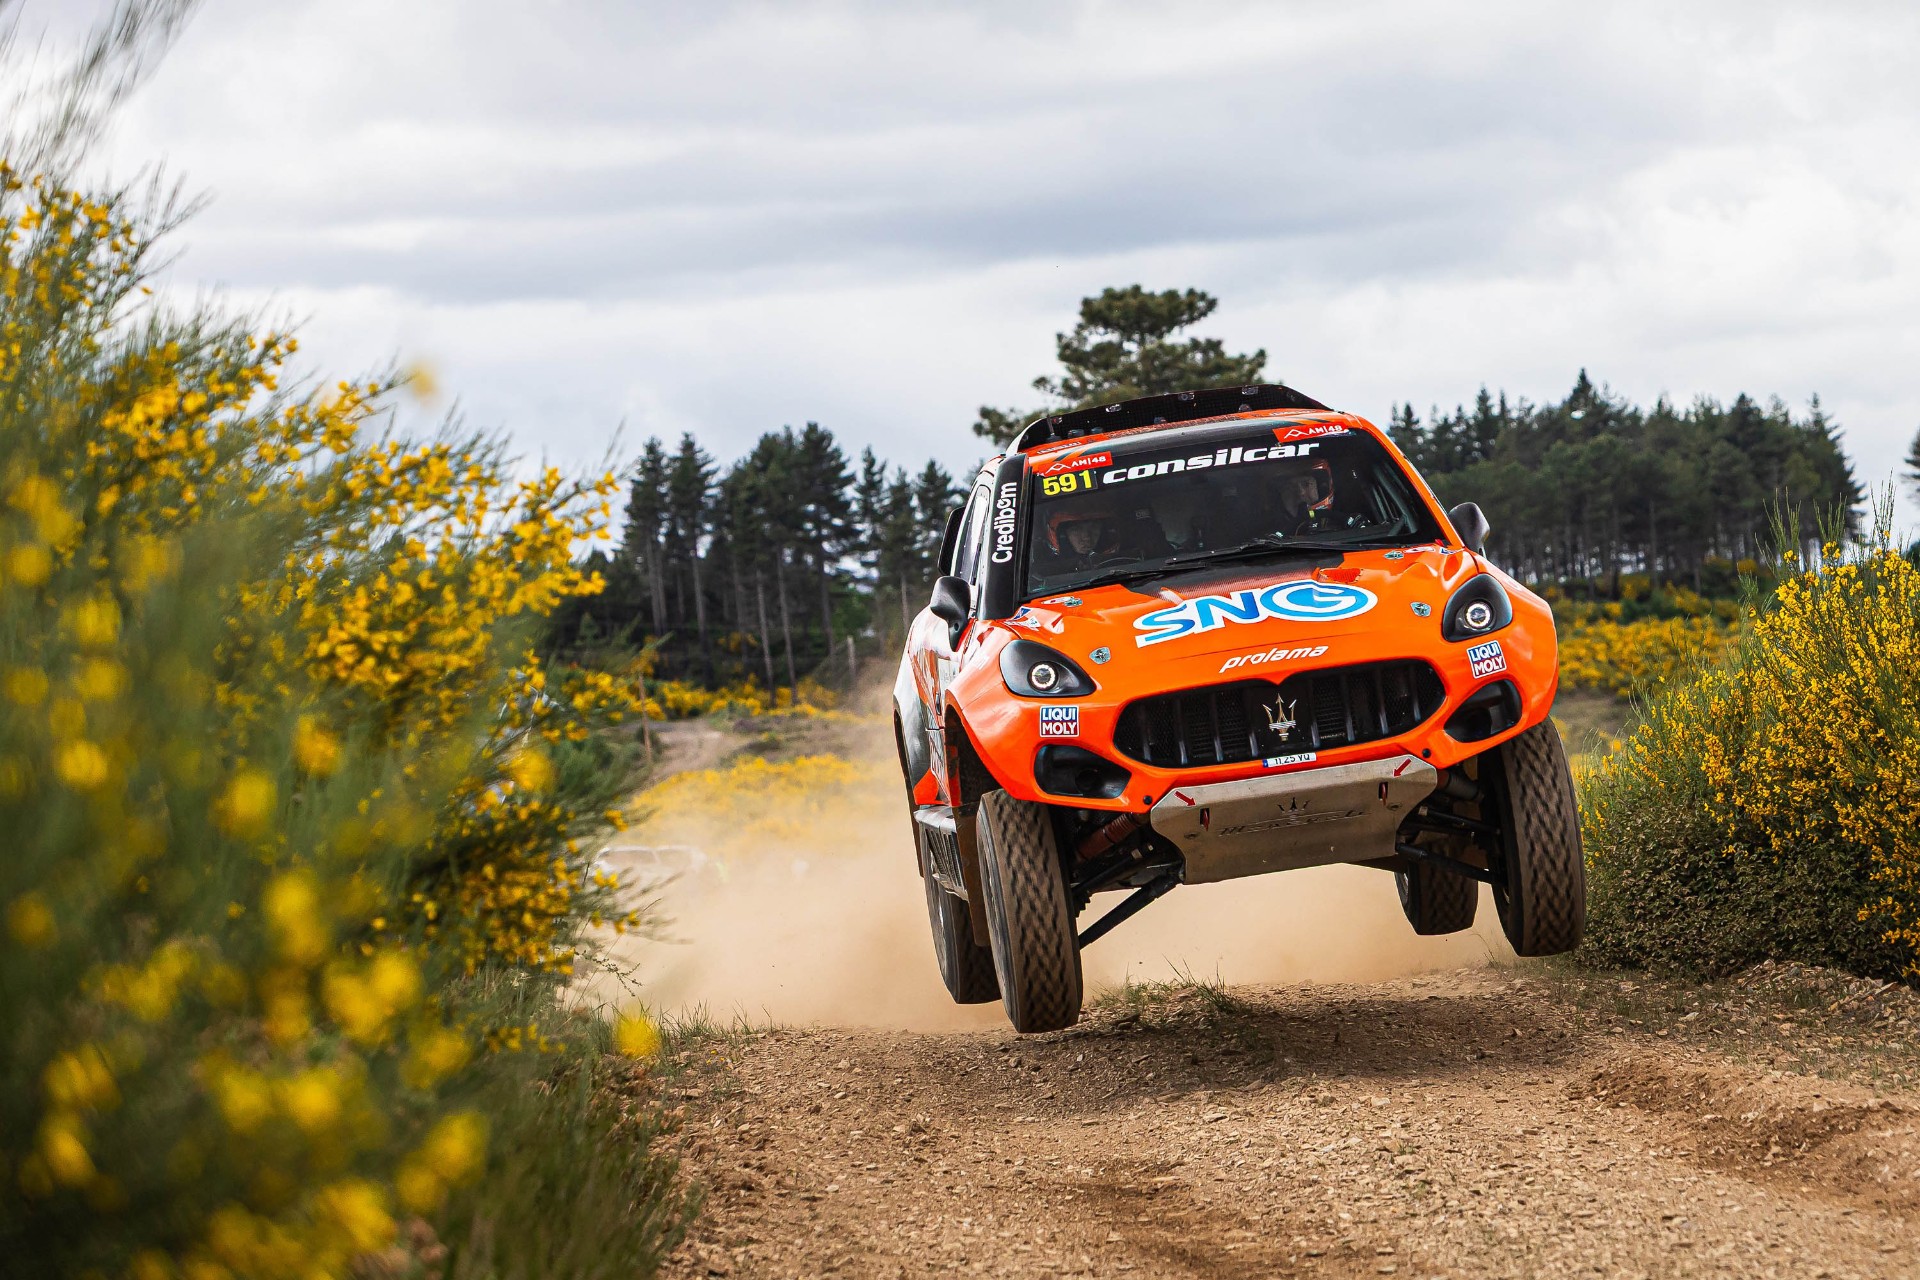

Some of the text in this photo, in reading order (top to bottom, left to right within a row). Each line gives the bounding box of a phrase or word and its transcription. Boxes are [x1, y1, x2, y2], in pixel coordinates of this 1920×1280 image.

[1103, 443, 1320, 484] consilcar
[1043, 470, 1092, 496] 591
[1133, 579, 1378, 648] SNG
[1219, 645, 1329, 673] prolama
[1469, 642, 1501, 662] LIQUI
[1473, 656, 1504, 676] MOLY
[1042, 707, 1076, 721] LIQUI
[1042, 722, 1077, 735] MOLY
